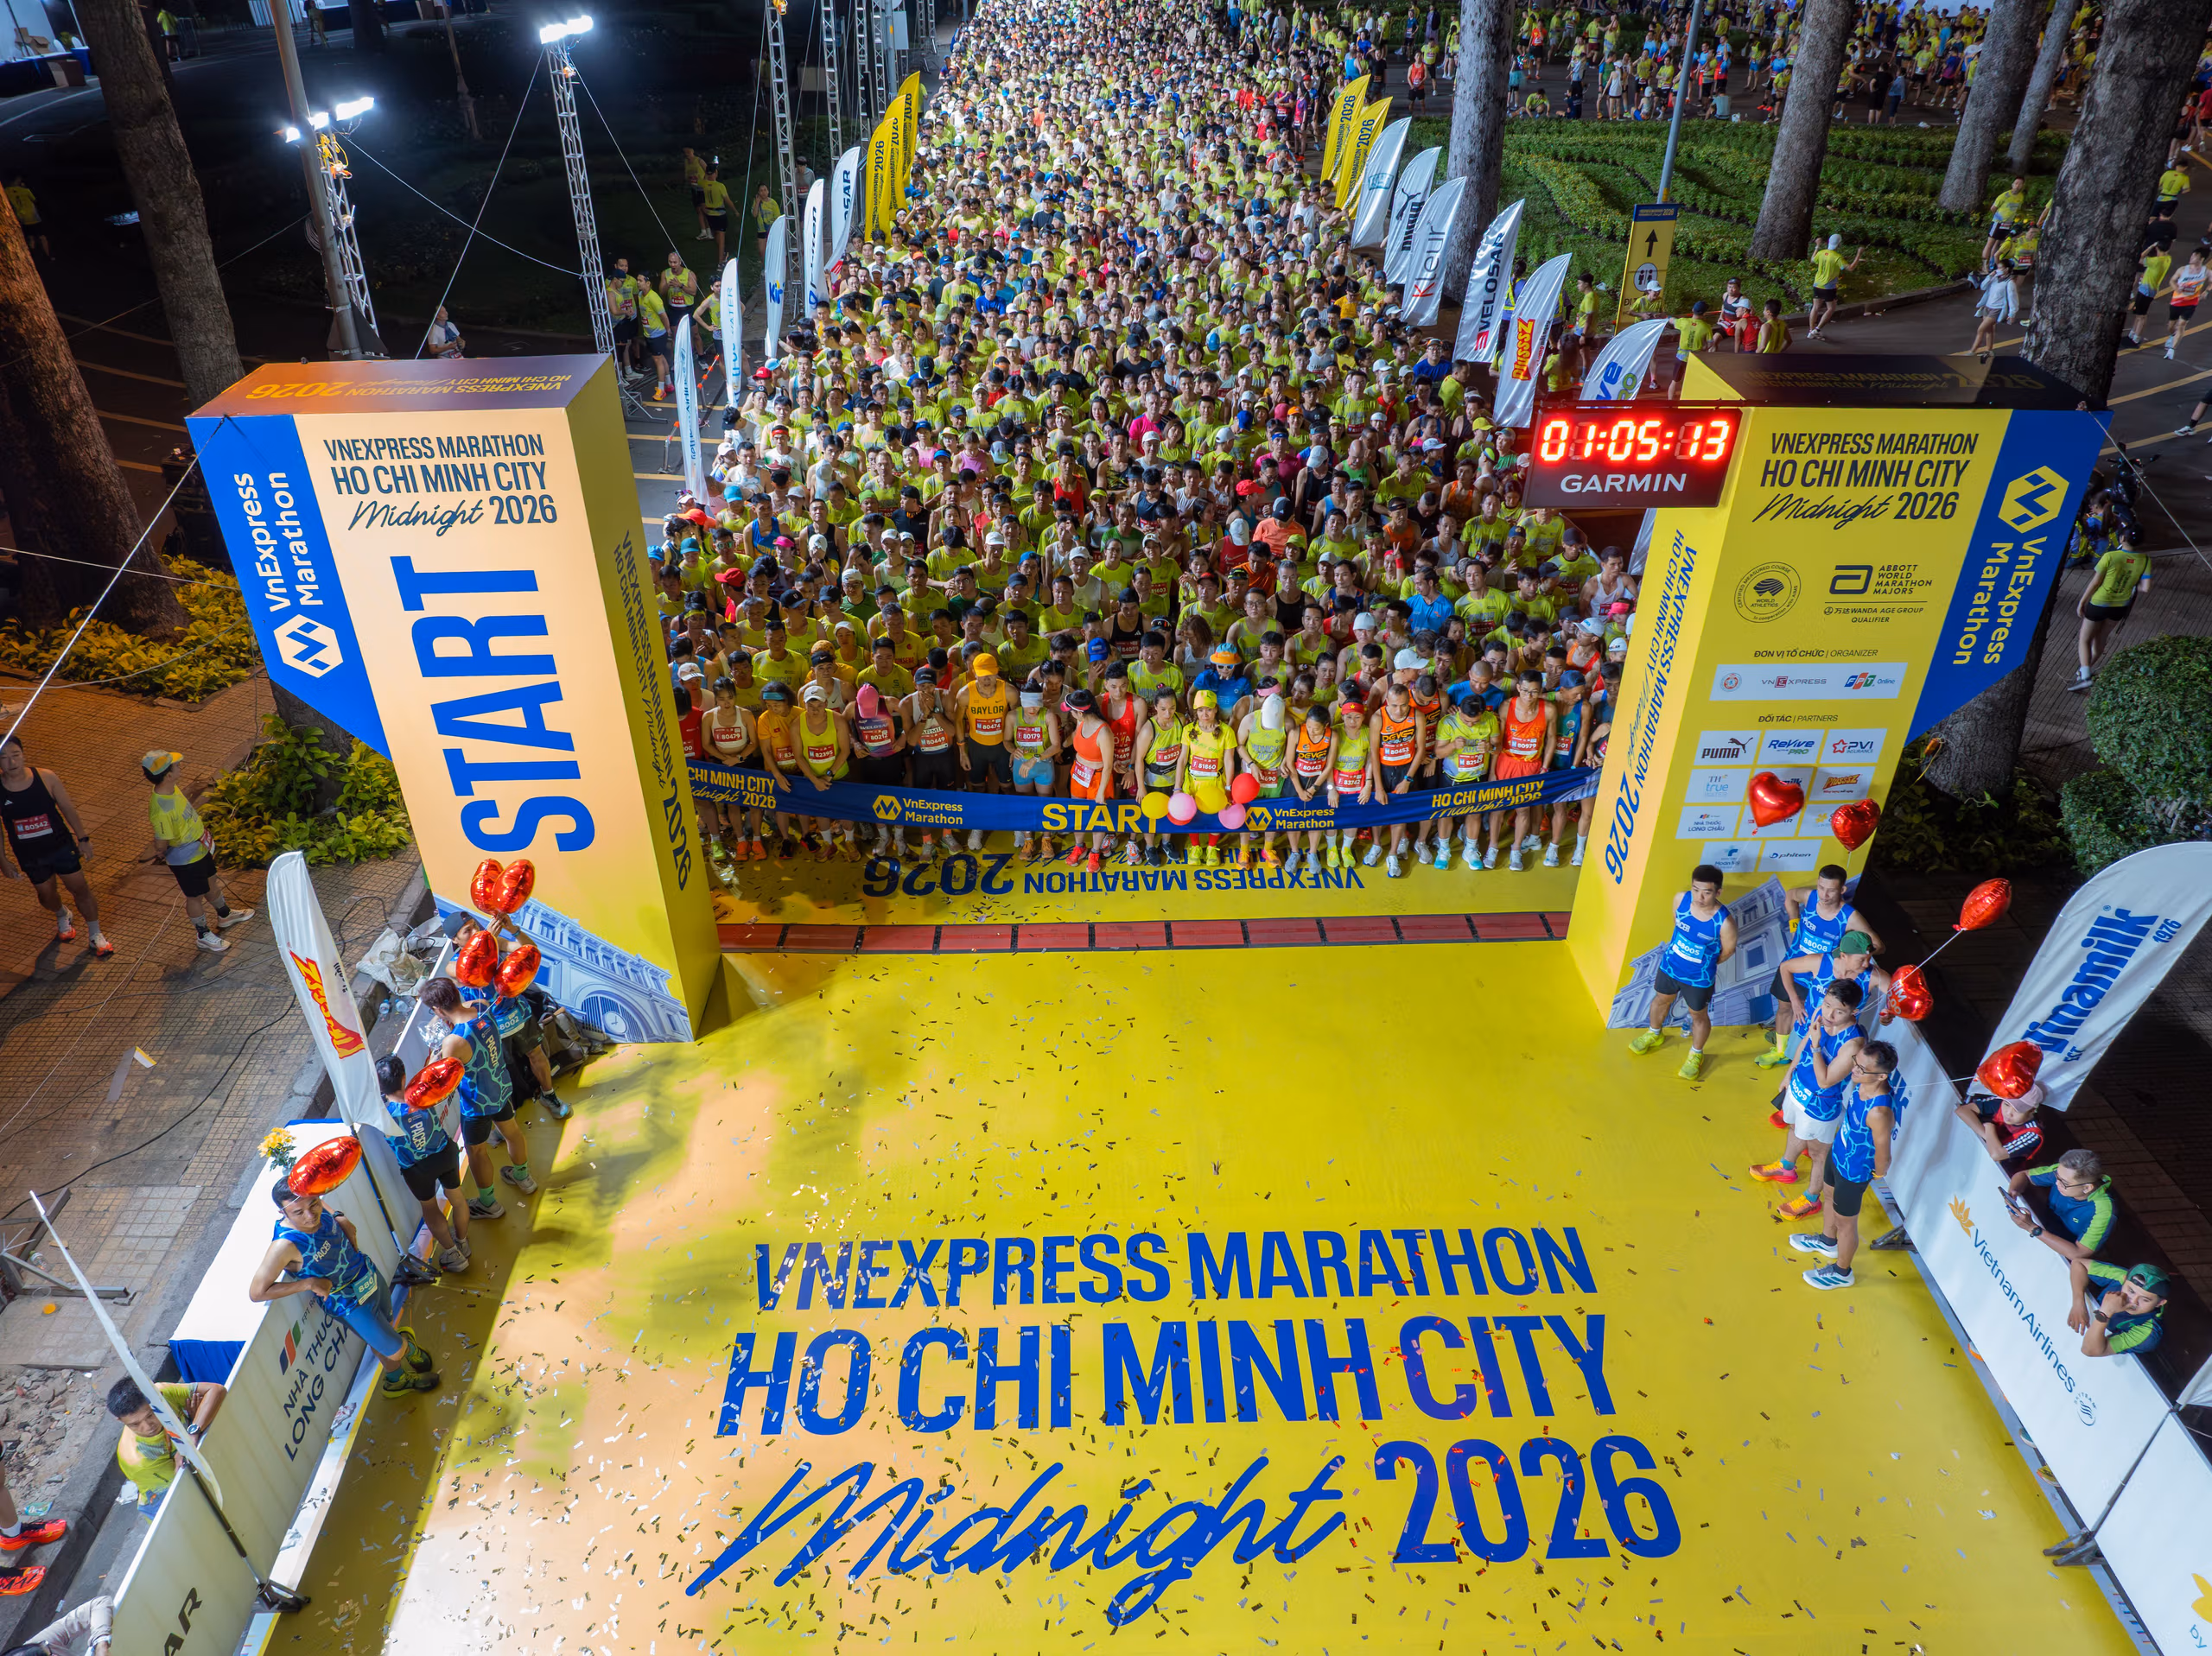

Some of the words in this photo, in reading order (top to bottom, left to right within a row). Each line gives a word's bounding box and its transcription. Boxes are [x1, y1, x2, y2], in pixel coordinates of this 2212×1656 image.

[1340, 95, 1356, 123] 2026
[1336, 124, 1345, 154] MARATHON
[1357, 118, 1375, 148] 2026
[874, 141, 885, 171] 2026
[1351, 149, 1362, 180] MARATHON
[246, 381, 354, 399] 2026
[345, 385, 449, 396] MARATHON
[454, 382, 562, 393] VNEXPRESS
[323, 436, 437, 462] VNEXPRESS
[436, 434, 545, 459] MARATHON
[1540, 420, 1730, 462] 01:05:13
[1771, 432, 1874, 454] VNEXPRESS
[1876, 433, 1980, 454] MARATHON
[330, 466, 371, 495] HO
[373, 464, 417, 494] CHI
[421, 463, 492, 493] MINH
[493, 460, 547, 491] CITY
[1560, 473, 1687, 493] GARMIN
[1760, 459, 1797, 487] HO
[1801, 460, 1844, 487] CHI
[1847, 460, 1913, 487] MINH
[1914, 460, 1968, 487] CITY
[347, 498, 485, 537] Midnight
[491, 493, 557, 525] 2026
[1751, 492, 1894, 530] Midnight
[1893, 491, 1960, 520] 2026
[233, 473, 291, 613] VnExpress
[268, 470, 324, 606] Marathon
[1672, 529, 1685, 558] HO
[1664, 558, 1678, 592] CHI
[1744, 565, 1770, 584] MEASURED
[1770, 564, 1791, 574] COURSE
[1654, 589, 1671, 639] MINH
[1660, 546, 1698, 674] VNEXPRESS
[1952, 542, 2014, 665] Marathon
[1984, 536, 2048, 665] VnExpress
[613, 544, 624, 574] HO
[620, 574, 631, 609] CHI
[626, 606, 640, 657] MINH
[636, 655, 649, 693] CITY
[1646, 636, 1660, 677] CITY
[1753, 650, 1775, 658] ĐƠN
[1775, 650, 1785, 659] VỊ
[1786, 648, 1798, 657] TỔ
[1798, 648, 1825, 657] CHỨC
[1830, 649, 1878, 657] ORGANIZER
[1761, 676, 1827, 688] VNEXPRESS
[1844, 672, 1877, 689] FPT
[390, 555, 594, 853] START
[622, 529, 652, 663] VNEXPRESS
[646, 659, 673, 779] MARATHON
[662, 777, 692, 892] 2026
[970, 705, 1004, 715] BAYLOR
[1758, 713, 1775, 722] ĐỐI
[1776, 714, 1792, 722] TÁC
[1634, 669, 1668, 790] MARATHON
[1163, 751, 1180, 760] 83923
[1303, 762, 1322, 771] 80443
[1701, 747, 1740, 758] PUMA
[687, 766, 709, 783] CHI
[709, 768, 746, 790] MINH
[747, 775, 776, 795] CITY
[1706, 782, 1729, 791] true
[742, 790, 777, 809] 2026
[903, 797, 963, 812] VnExpress
[1431, 793, 1452, 808] HO
[1452, 790, 1477, 805] CHI
[1478, 785, 1514, 803] MINH
[24, 821, 48, 831] 80542
[904, 810, 963, 825] Marathon
[1274, 807, 1335, 820] VnExpress
[1275, 817, 1335, 830] Marathon
[1605, 770, 1643, 885] 2026
[862, 853, 1014, 897] 2026
[1024, 870, 1188, 894] MARATHON
[1196, 868, 1365, 891] VNEXPRESS
[1802, 917, 1816, 932] PACER
[2152, 918, 2183, 944] 1976
[1676, 939, 1700, 955] 88005
[1803, 937, 1827, 952] 88008
[2019, 908, 2160, 1054] Vinamilk
[499, 1016, 519, 1031] 8002
[2063, 1045, 2083, 1063] EST
[410, 1121, 426, 1151] PACER
[314, 1240, 331, 1262] PACER
[753, 1231, 1173, 1312] VNEXPRESS
[1187, 1226, 1599, 1301] MARATHON
[358, 1276, 374, 1293] 880
[302, 1302, 316, 1325] FPT
[1973, 1227, 2025, 1316] Vietnam
[2020, 1311, 2077, 1393] Airlines
[714, 1329, 871, 1437] HO
[893, 1322, 1072, 1434] CHI
[1100, 1317, 1384, 1430] MINH
[1397, 1313, 1616, 1422] CITY
[283, 1370, 313, 1418] NHÀ
[284, 1374, 327, 1462] LONG
[683, 1455, 1346, 1627] Midnight
[1371, 1435, 1682, 1564] 2026
